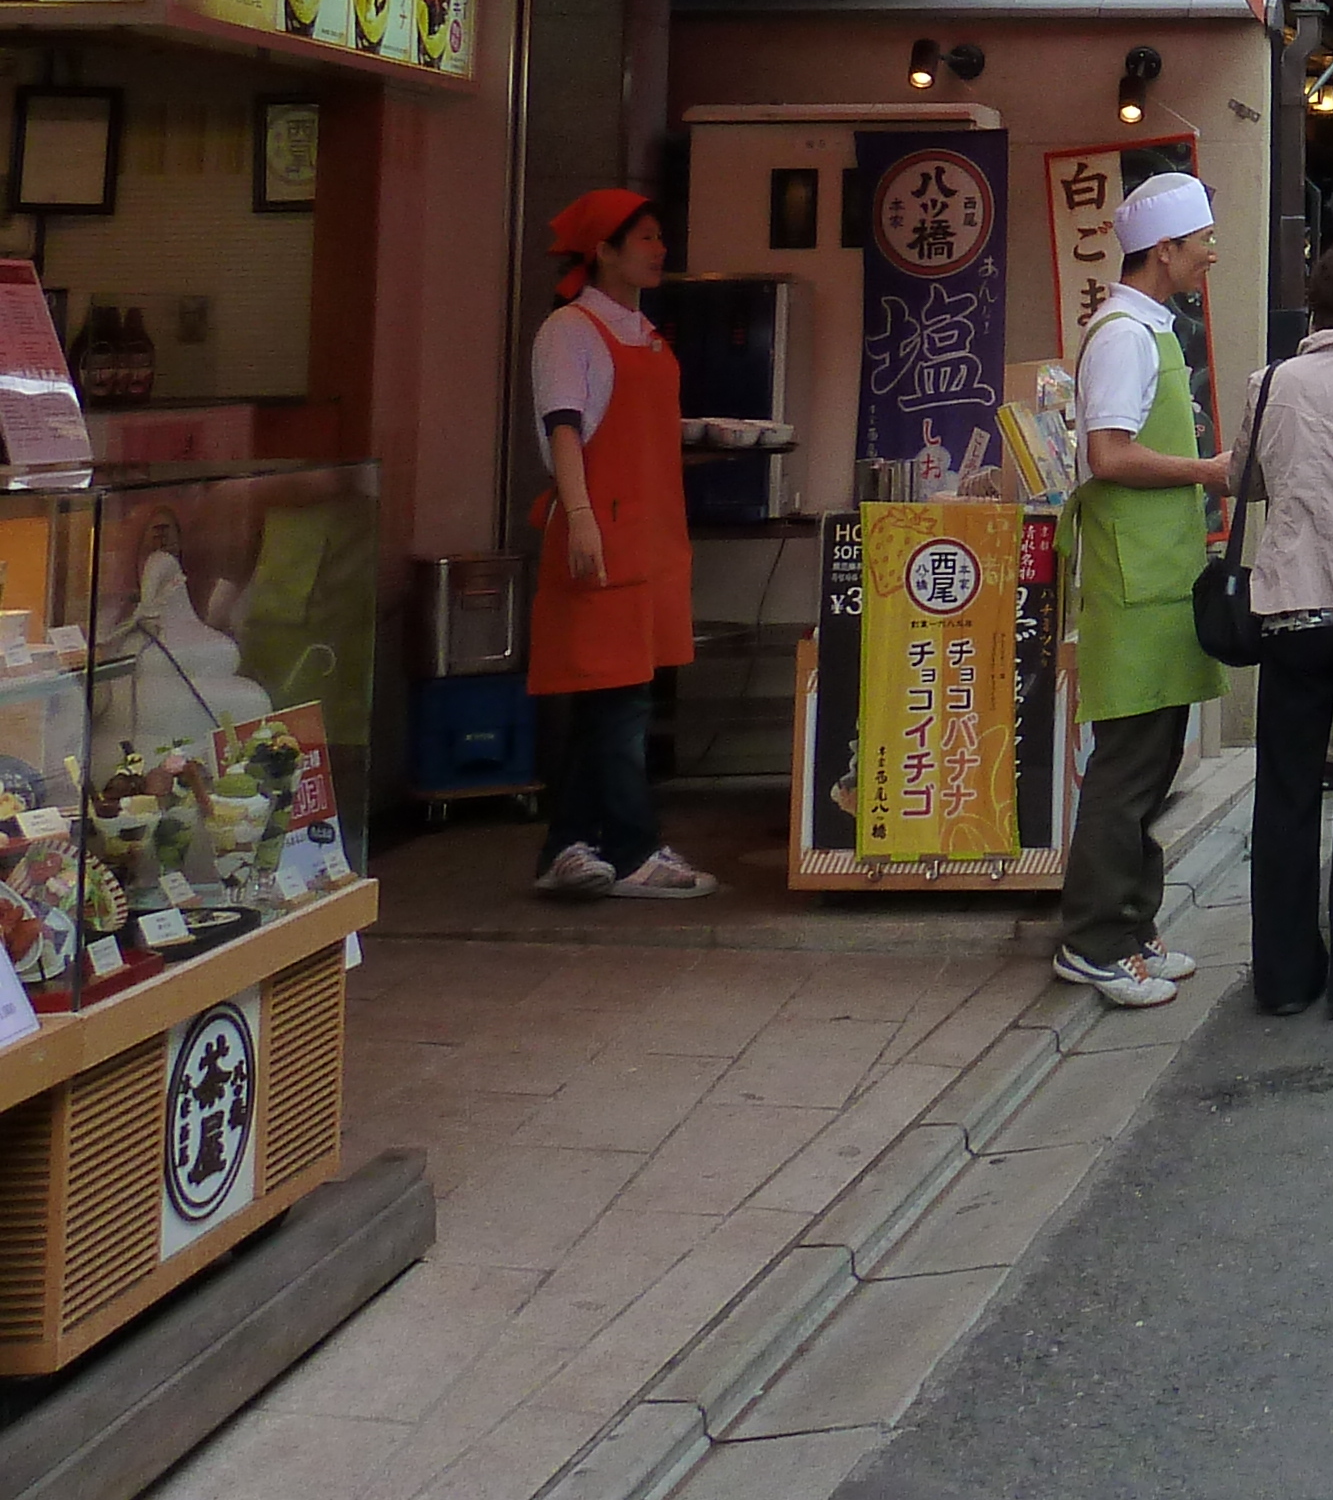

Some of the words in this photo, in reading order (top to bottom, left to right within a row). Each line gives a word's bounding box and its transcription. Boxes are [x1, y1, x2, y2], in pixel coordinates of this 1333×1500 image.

[889, 198, 905, 229] 本家
[963, 197, 978, 227] 西尾
[865, 282, 996, 413] 塩
[922, 417, 943, 480] しお
[833, 544, 863, 561] SOF
[835, 523, 863, 542] HO
[927, 551, 958, 604] 西尾
[830, 586, 863, 616] ¥3
[901, 640, 937, 818] チョコイチゴ
[942, 639, 980, 818] チョコバナナ
